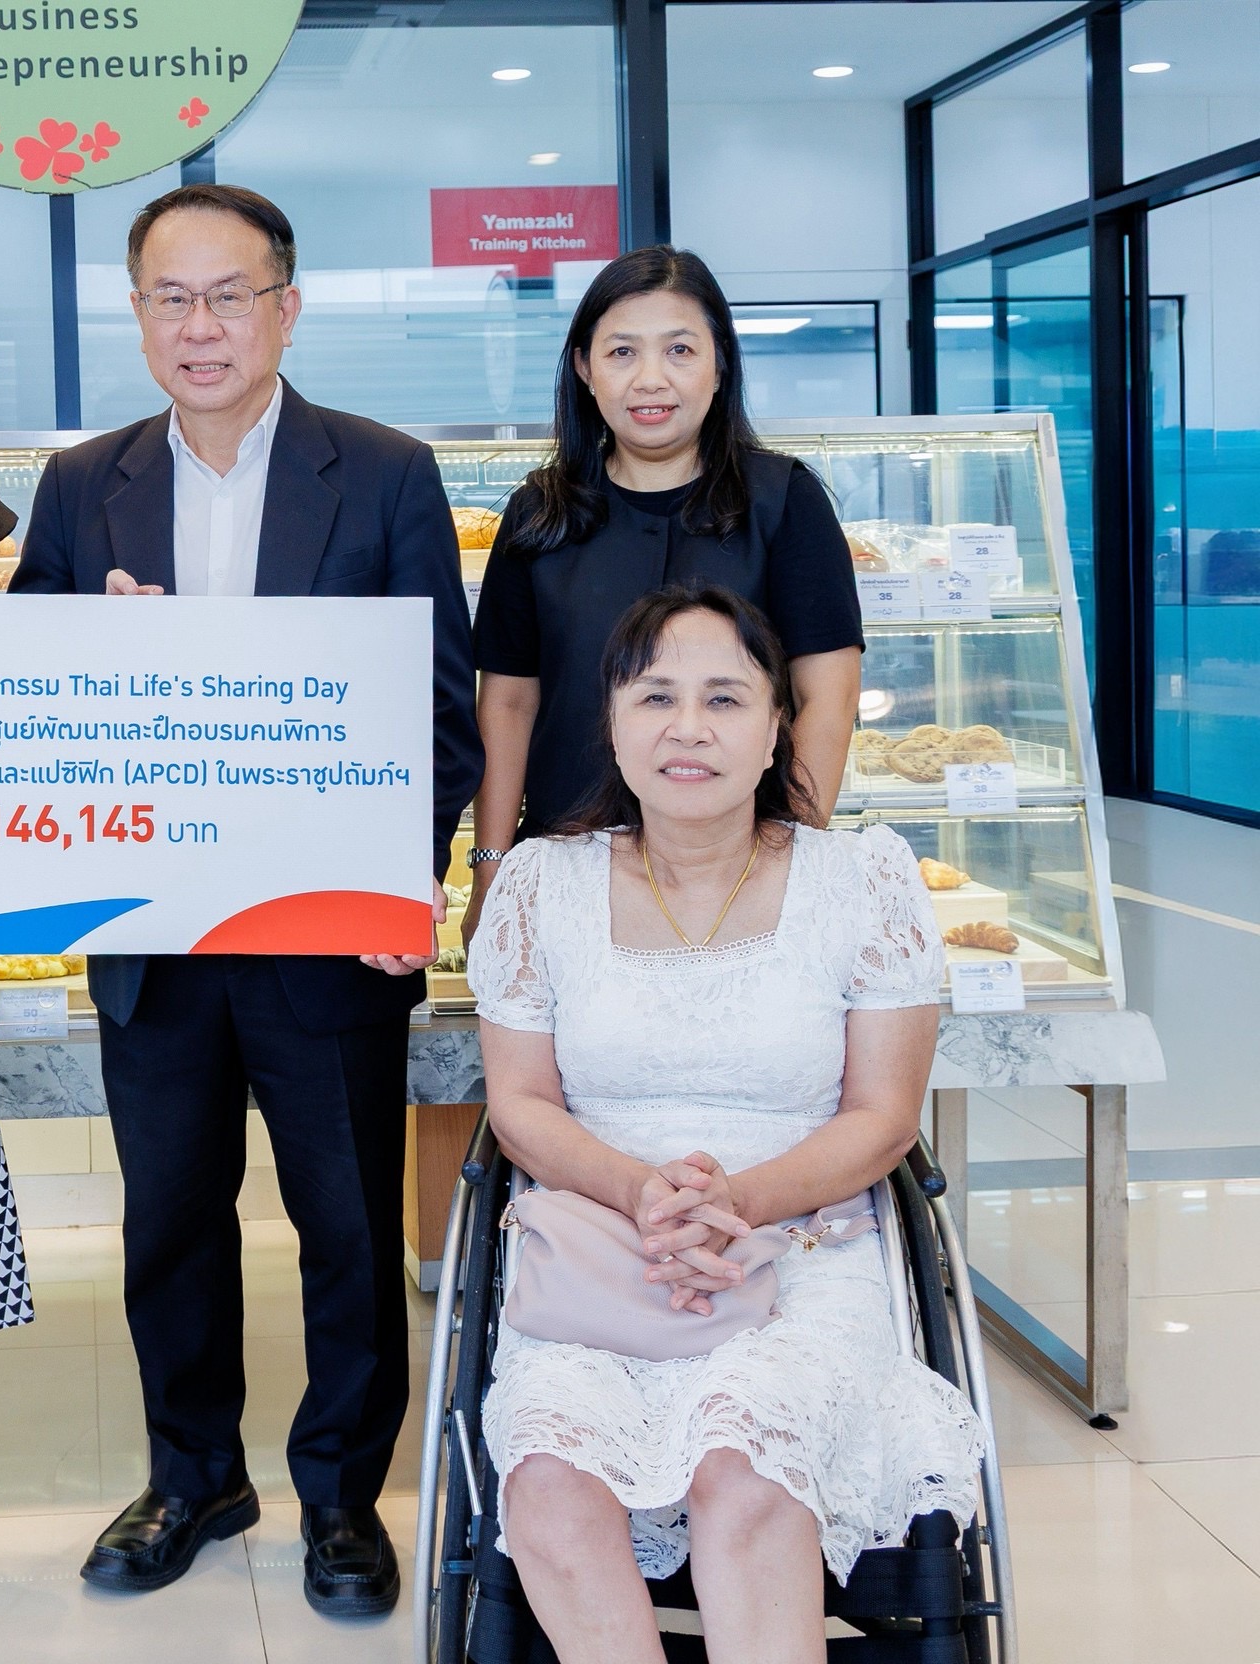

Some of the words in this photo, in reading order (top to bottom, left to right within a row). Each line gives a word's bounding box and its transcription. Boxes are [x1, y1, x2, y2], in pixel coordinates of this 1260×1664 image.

[482, 212, 574, 230] Yamazaki
[469, 237, 528, 252] Training
[531, 236, 586, 249] Kitchen
[975, 547, 989, 555] 28
[879, 592, 892, 601] 35
[948, 591, 962, 600] 28
[68, 673, 119, 697] Thai
[130, 673, 193, 697] Life's
[201, 674, 294, 704] Sharing
[303, 676, 349, 704] Day
[124, 758, 208, 787] (APCD)
[215, 759, 410, 793] ในพระราชูปถัมภ์ฯ
[973, 784, 988, 793] 38
[167, 821, 218, 843] บาท
[980, 982, 994, 991] 28
[23, 1008, 38, 1018] 50
